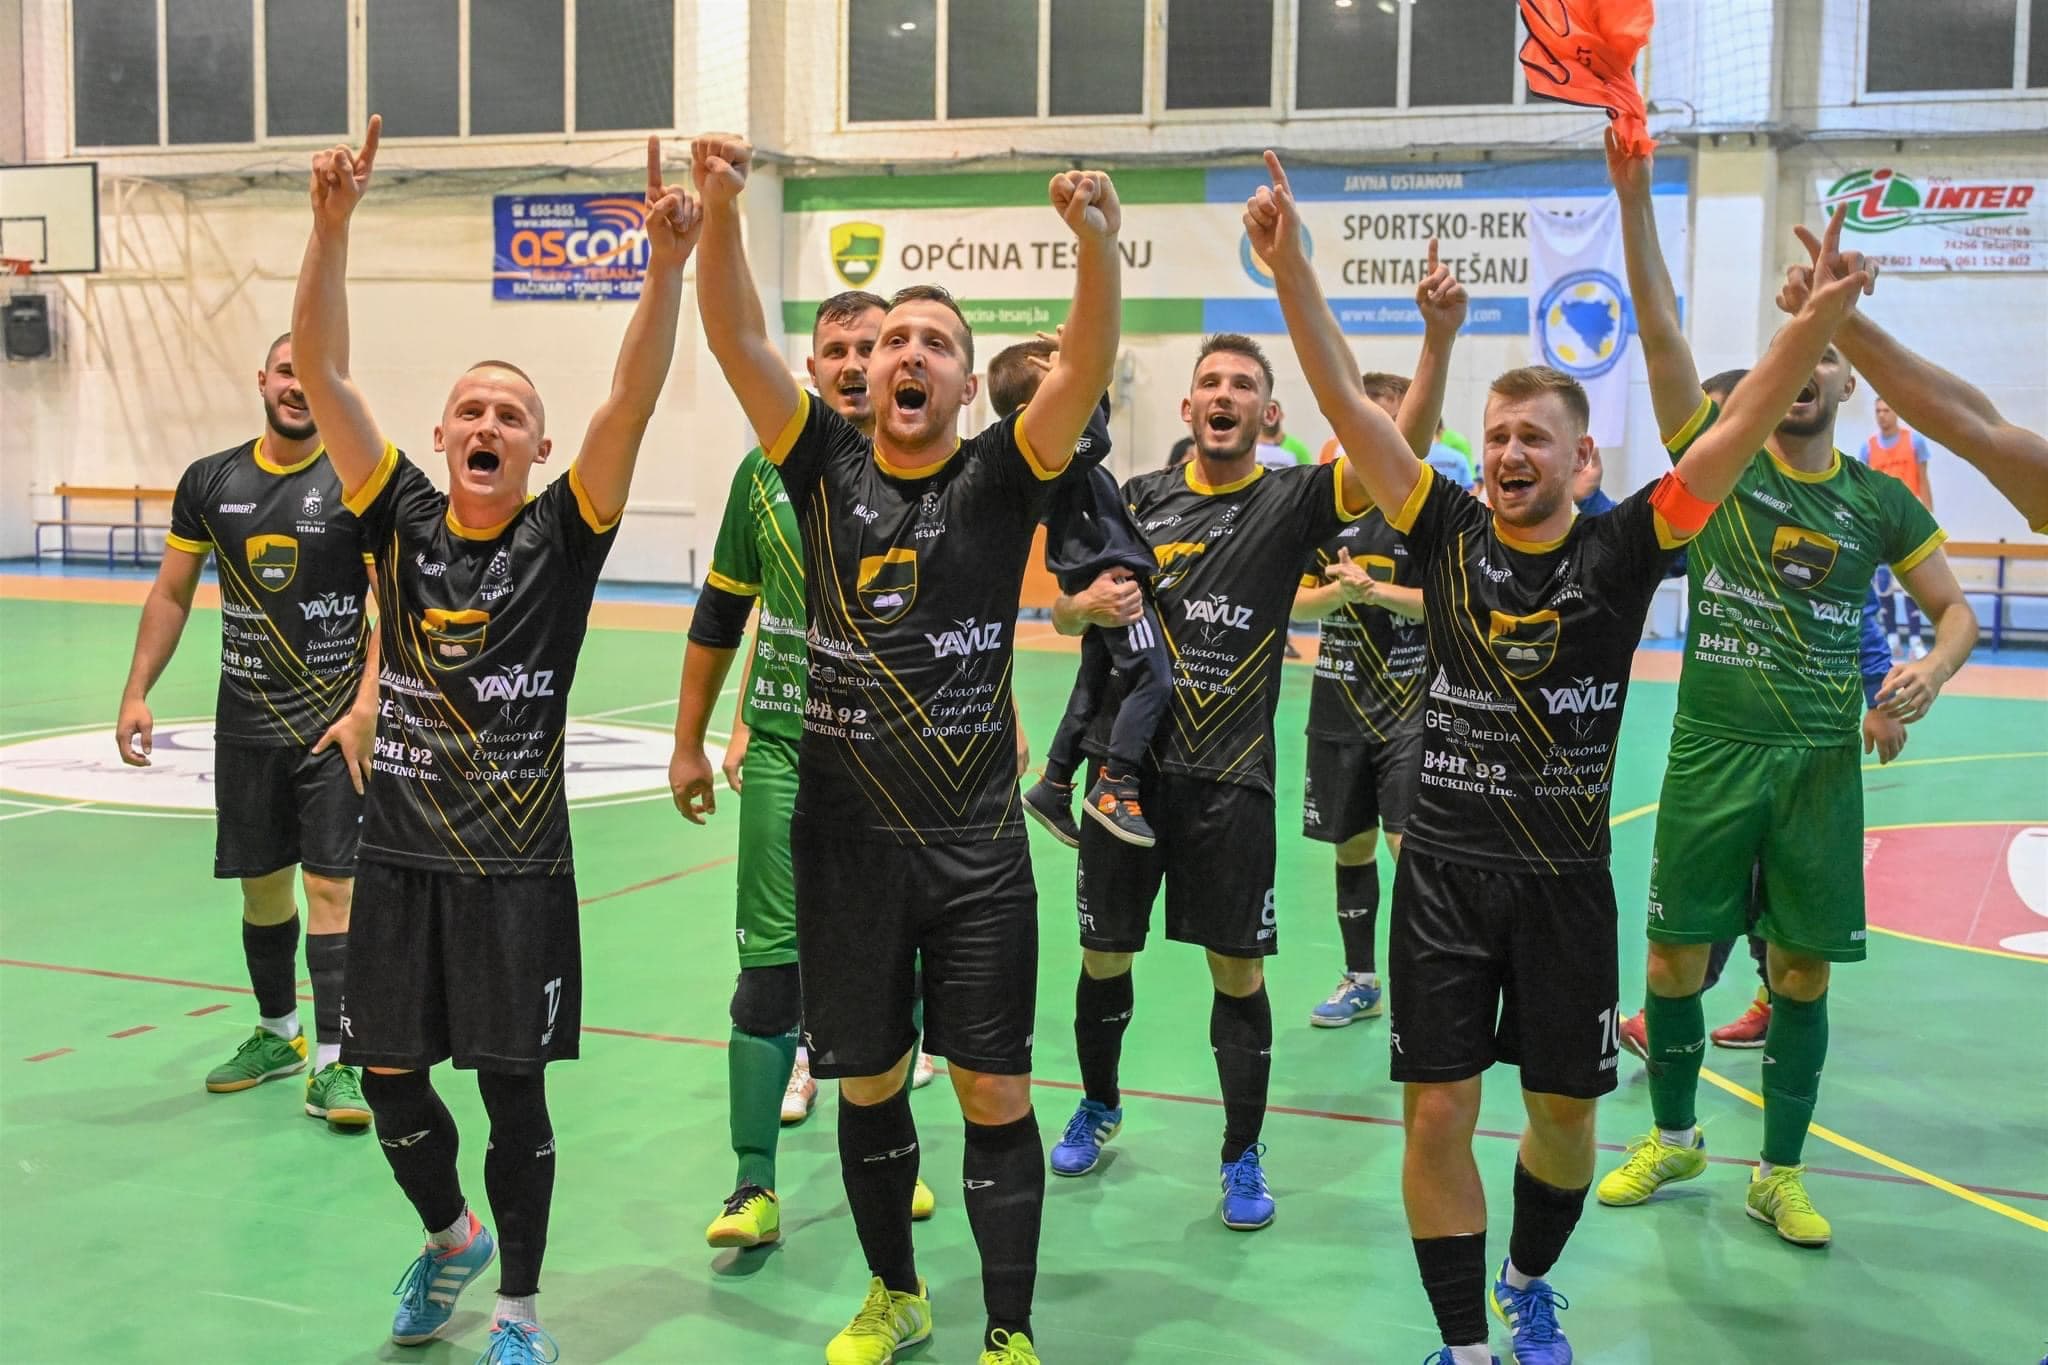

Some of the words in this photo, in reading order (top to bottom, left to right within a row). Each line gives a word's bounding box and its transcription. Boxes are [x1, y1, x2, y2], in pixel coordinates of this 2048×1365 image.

[1344, 175, 1387, 192] JAVNA
[1391, 174, 1463, 190] USTANOVA
[1924, 186, 2034, 208] INTER
[900, 235, 1022, 270] OPĆINA
[1031, 235, 1152, 270] TEŠNJ
[298, 594, 358, 621] YAVUZ
[1183, 598, 1253, 631] YAVUZ
[240, 631, 270, 641] MEDIA
[924, 622, 1002, 658] YAVUZ
[1746, 642, 1771, 657] 92
[244, 655, 263, 669] 92
[1336, 659, 1354, 672] 92
[1694, 651, 1753, 667] TRUCKING
[1758, 660, 1781, 671] Inc.
[468, 669, 554, 702] YAVUZ
[838, 675, 880, 688] MEDIA
[1172, 676, 1208, 691] VORAC
[1451, 685, 1494, 702] UGARAK
[1539, 682, 1620, 714] YAVUZ
[404, 714, 449, 730] MEDIA
[838, 707, 867, 725] 92
[850, 729, 875, 740] Inc.
[922, 723, 971, 738] DVORAC
[1471, 729, 1520, 742] MEDIA
[409, 746, 433, 766] 92
[373, 759, 416, 777] RUCKING
[420, 769, 442, 782] Inc.
[465, 769, 517, 781] DVORAC
[1475, 763, 1507, 781] 92
[1420, 772, 1485, 793] TRUCKING
[1489, 784, 1517, 797] Inc.
[1535, 784, 1584, 796] DVORAC
[1262, 888, 1275, 926] 8
